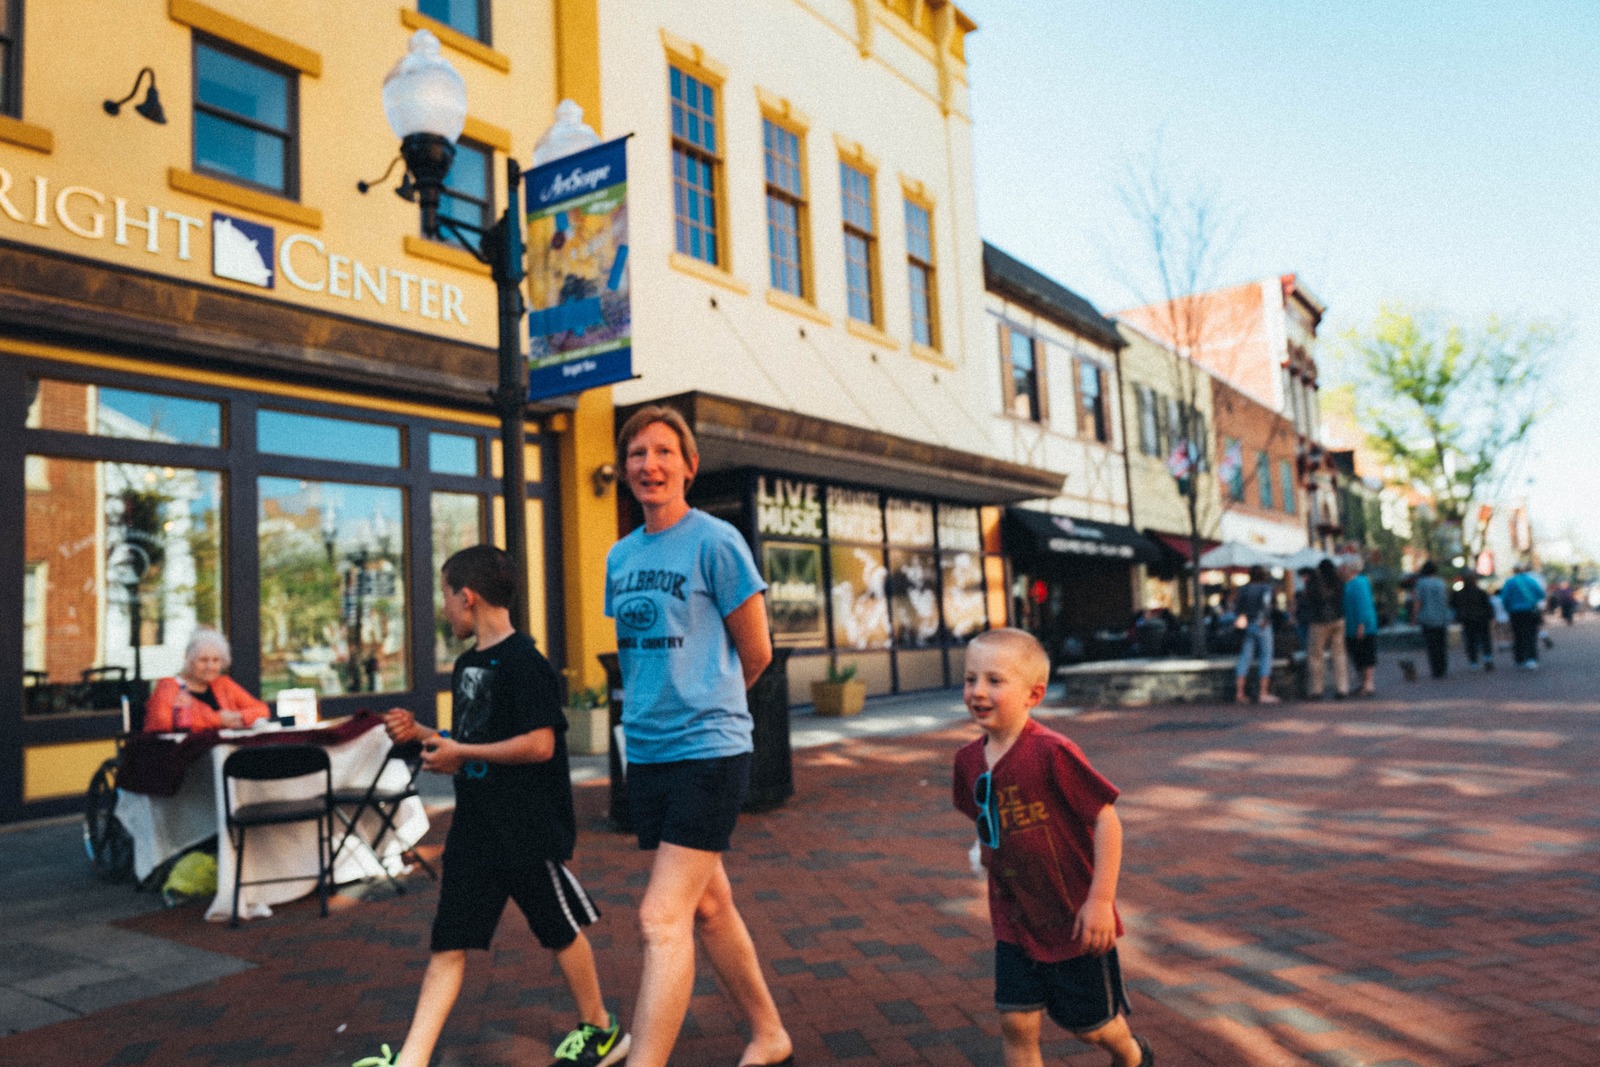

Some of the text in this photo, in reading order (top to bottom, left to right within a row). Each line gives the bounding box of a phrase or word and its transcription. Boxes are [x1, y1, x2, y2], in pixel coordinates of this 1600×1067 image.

[279, 233, 469, 326] CENTER
[758, 475, 821, 511] LIVE
[757, 502, 823, 538] MUSIC
